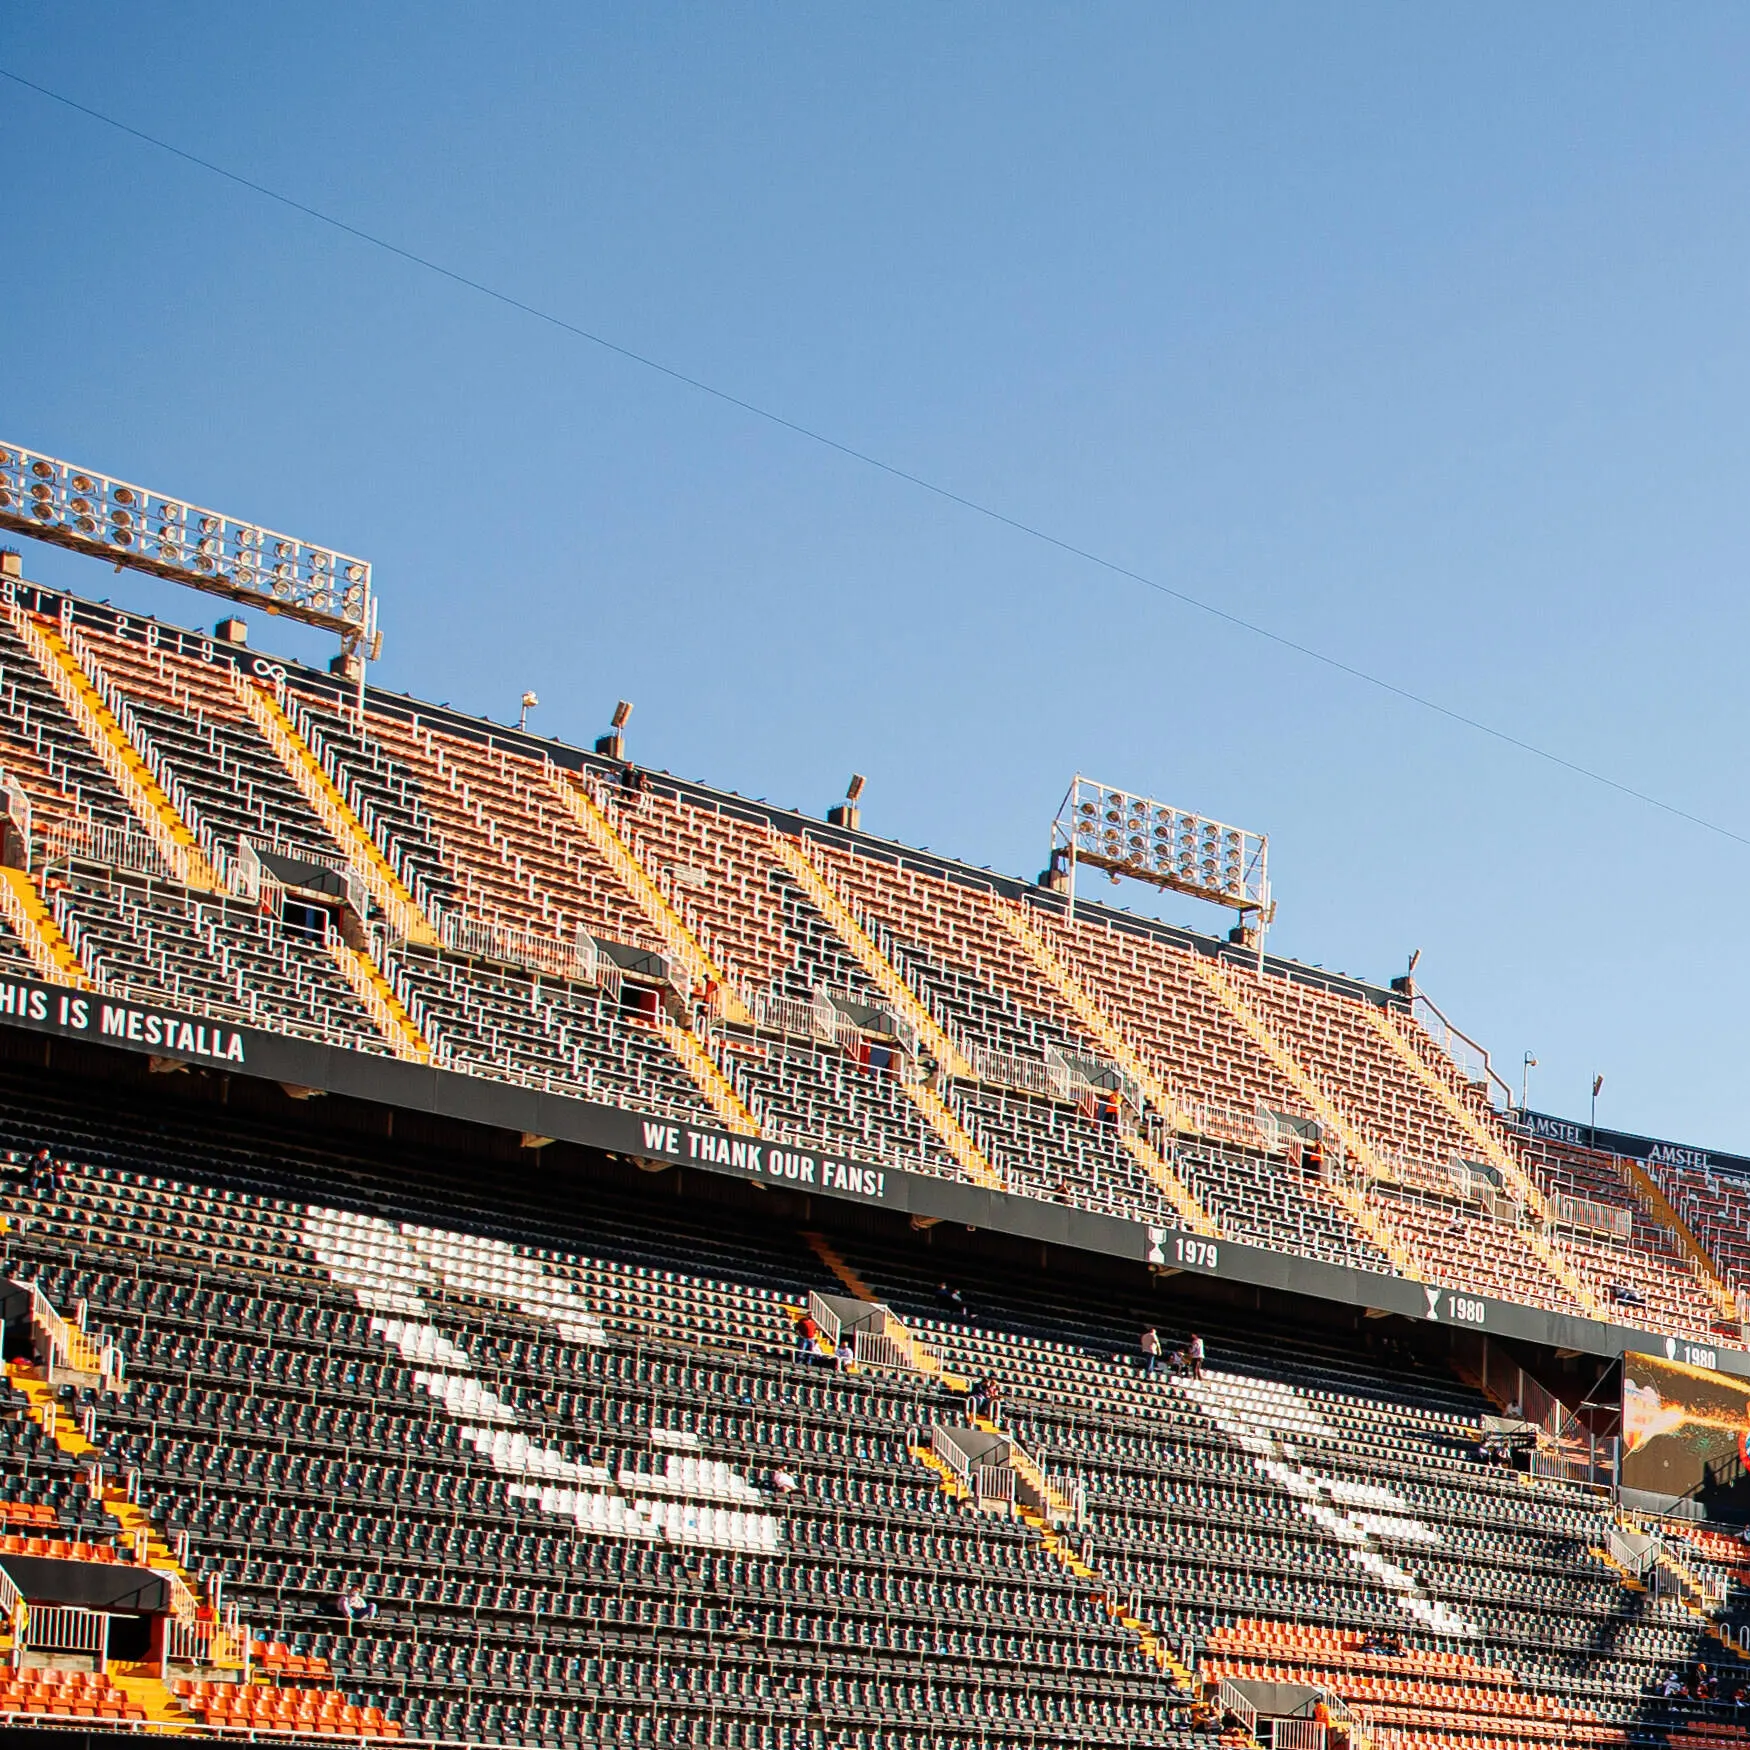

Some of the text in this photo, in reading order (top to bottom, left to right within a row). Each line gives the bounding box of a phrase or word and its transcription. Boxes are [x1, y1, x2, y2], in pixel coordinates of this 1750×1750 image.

[60, 995, 90, 1030] IS
[102, 1005, 245, 1064] MESTALLA
[1525, 1116, 1583, 1145] AMSTEL
[643, 1122, 885, 1198] WE THANK OUR FANS!
[1649, 1144, 1709, 1170] AMSTEL
[1175, 1239, 1218, 1268] 1979
[1448, 1296, 1485, 1322] 1980
[1683, 1345, 1717, 1369] 1980
